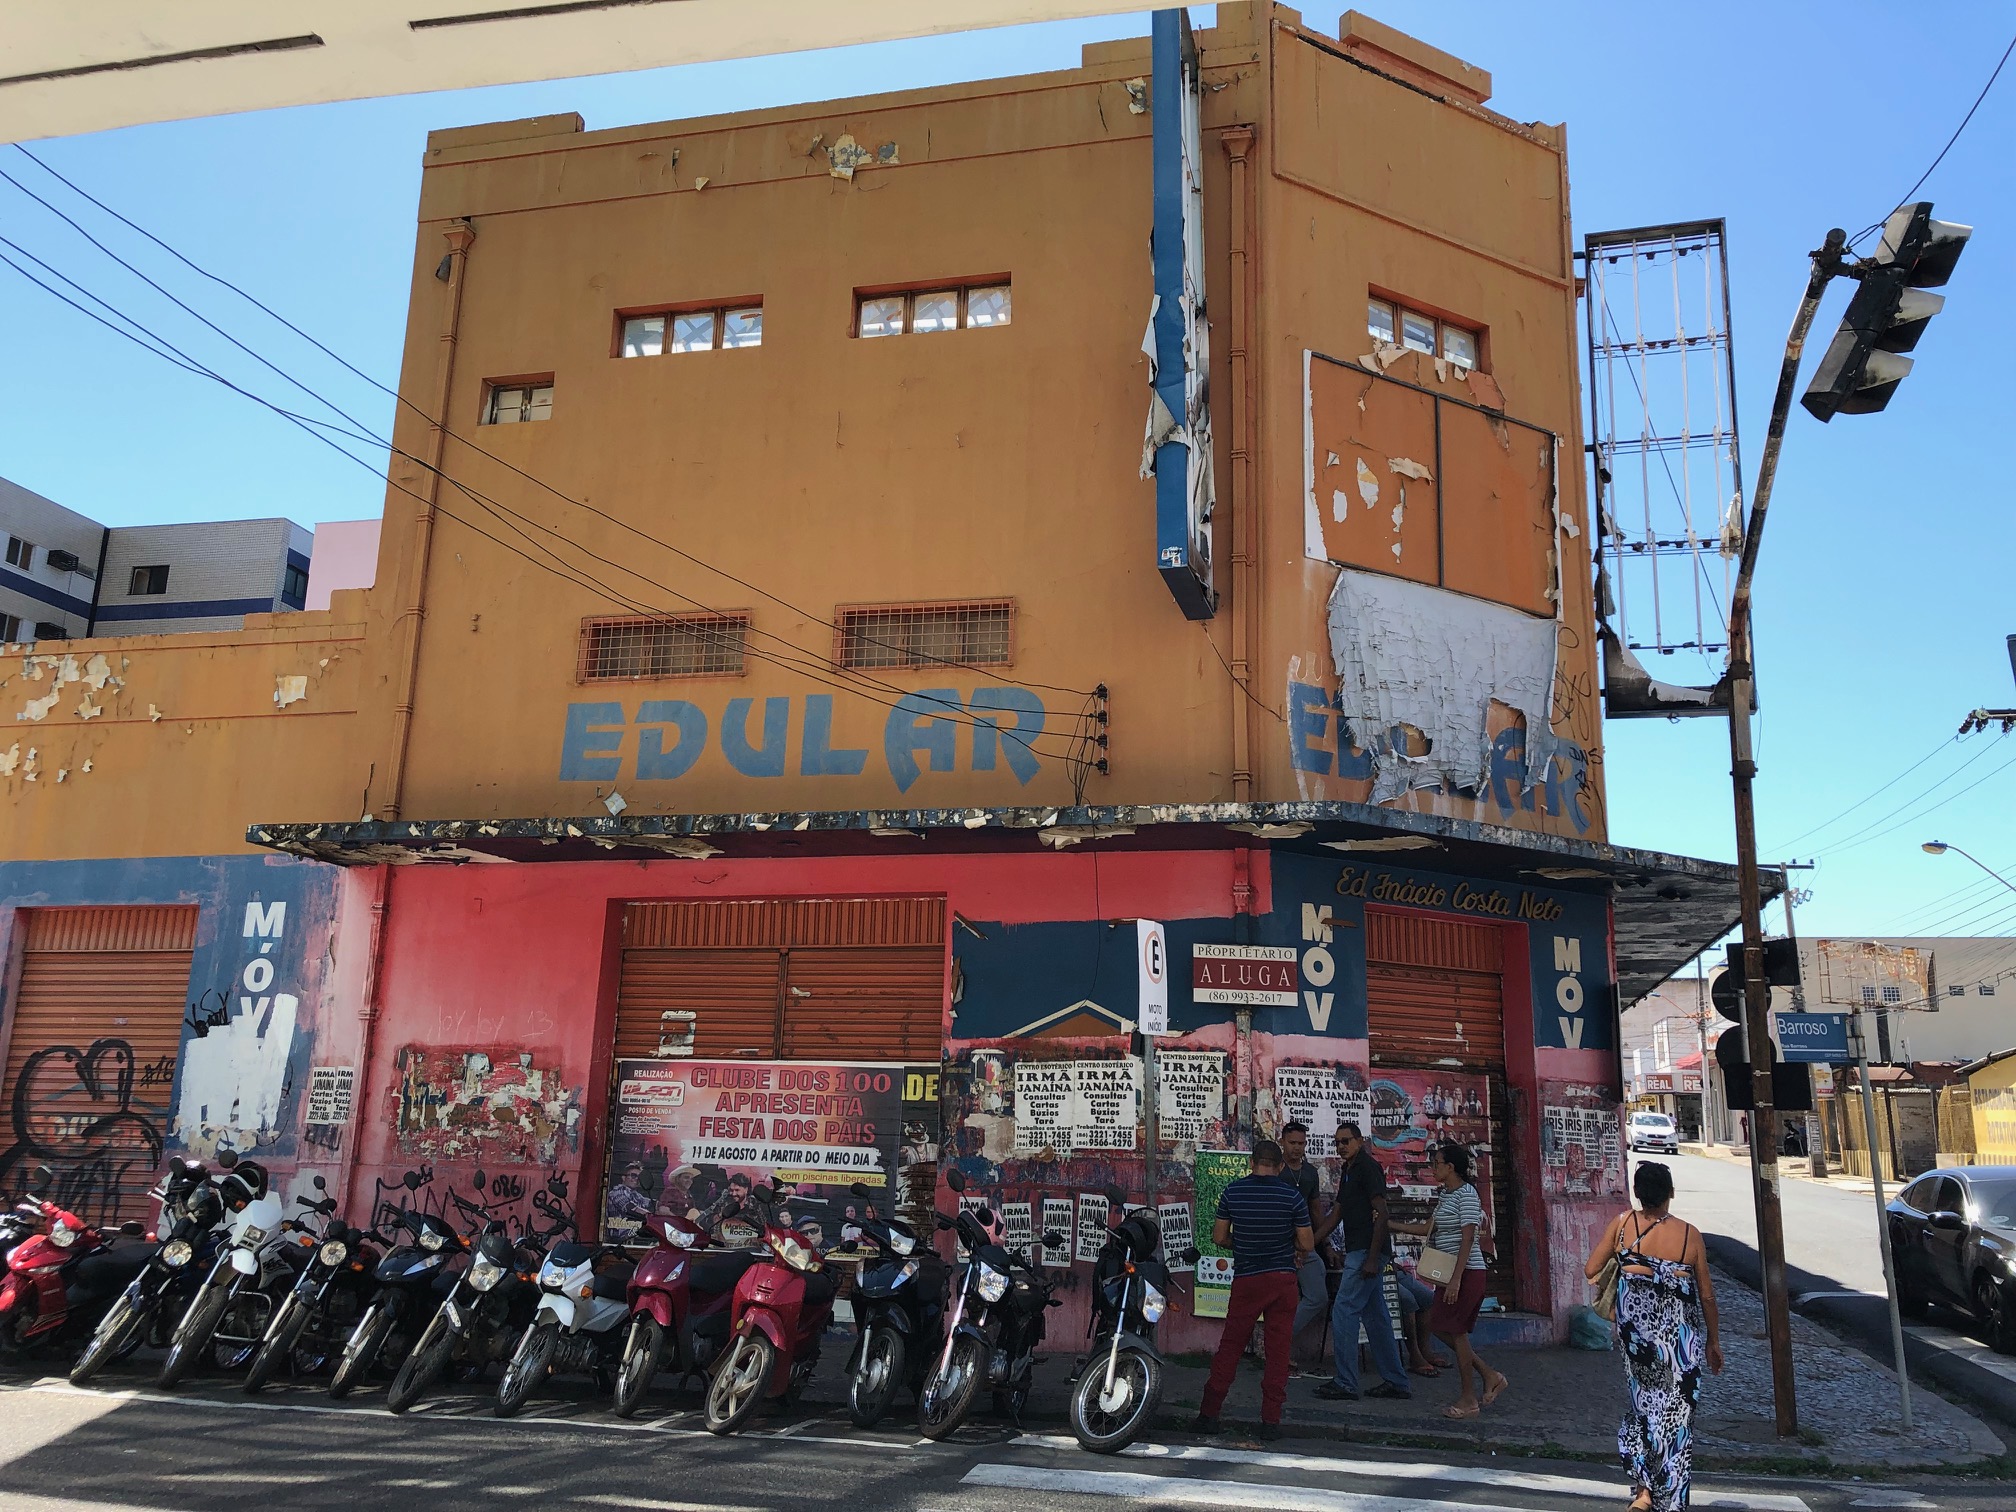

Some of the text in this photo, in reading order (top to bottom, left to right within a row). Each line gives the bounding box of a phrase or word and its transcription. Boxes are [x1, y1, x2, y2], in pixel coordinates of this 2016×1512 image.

[560, 687, 1046, 795] EDULAR
[1373, 872, 1446, 908] Inácio
[1452, 882, 1511, 916] Costa
[1517, 891, 1564, 921] Neto
[1197, 946, 1293, 960] PROPRIETÁRIO
[1302, 902, 1335, 1032] MÓV
[1200, 962, 1291, 987] ALUGA
[1208, 990, 1282, 1003] (86) 9933-2617
[1148, 1003, 1162, 1015] MOTO
[1776, 1018, 1828, 1035] Barroso
[1188, 1054, 1222, 1062] ESOTÉRICO
[1163, 1062, 1220, 1073] IRMÃ
[633, 1069, 673, 1079] REALIZAÇÃO
[1017, 1070, 1072, 1082] IRMÃ
[1077, 1069, 1133, 1080] IRMÃ
[1162, 1073, 1221, 1084] JANAÍNA
[690, 1067, 892, 1093] CLUBE DOS 100
[1278, 1077, 1323, 1088] IRMÃ
[1647, 1080, 1672, 1090] REAL
[902, 1073, 939, 1102] DE
[1017, 1081, 1072, 1092] JANAÍNA
[1077, 1080, 1134, 1092] JANAÍNA
[1169, 1083, 1213, 1092] Consultas
[1023, 1093, 1066, 1101] Consultas
[1083, 1092, 1127, 1100] Consultas
[1176, 1092, 1206, 1100] Cartas
[1280, 1088, 1324, 1100] JANAÍNA
[715, 1091, 864, 1117] APRESENTA
[1090, 1100, 1120, 1108] Cartas
[1176, 1100, 1206, 1109] Búzios
[1283, 1099, 1319, 1108] Consultas
[1330, 1101, 1365, 1109] Consultas
[1030, 1109, 1059, 1117] Búzios
[1090, 1108, 1120, 1116] Búzios
[1289, 1107, 1313, 1115] Cartas
[698, 1116, 766, 1139] FESTA
[772, 1118, 818, 1142] DOS
[1565, 1119, 1582, 1132] IRIS
[1601, 1122, 1619, 1135] IRIS
[1088, 1131, 1132, 1139] 3221-7455
[1028, 1140, 1071, 1148] 9566-4270
[1088, 1139, 1132, 1147] 9566-4270
[704, 1147, 717, 1160] DE
[718, 1147, 757, 1161] AGOSTO
[761, 1149, 769, 1161] A
[770, 1149, 803, 1163] PARTIR
[805, 1151, 820, 1164] DO
[825, 1151, 850, 1165] MEIO
[852, 1152, 870, 1166] DIA
[1219, 1155, 1247, 1166] FAÇA
[1208, 1166, 1235, 1177] SUAS
[802, 1173, 839, 1184] piscinas
[840, 1173, 882, 1184] liberadas
[1044, 1202, 1072, 1212] IRMÃ
[1080, 1197, 1107, 1208] IRMÃ
[1003, 1206, 1030, 1216] IRMÃ
[1160, 1205, 1188, 1217] IRMÃ
[1078, 1230, 1106, 1240] Búzios
[1163, 1231, 1191, 1240] Cartas
[1164, 1240, 1192, 1250] Búzios
